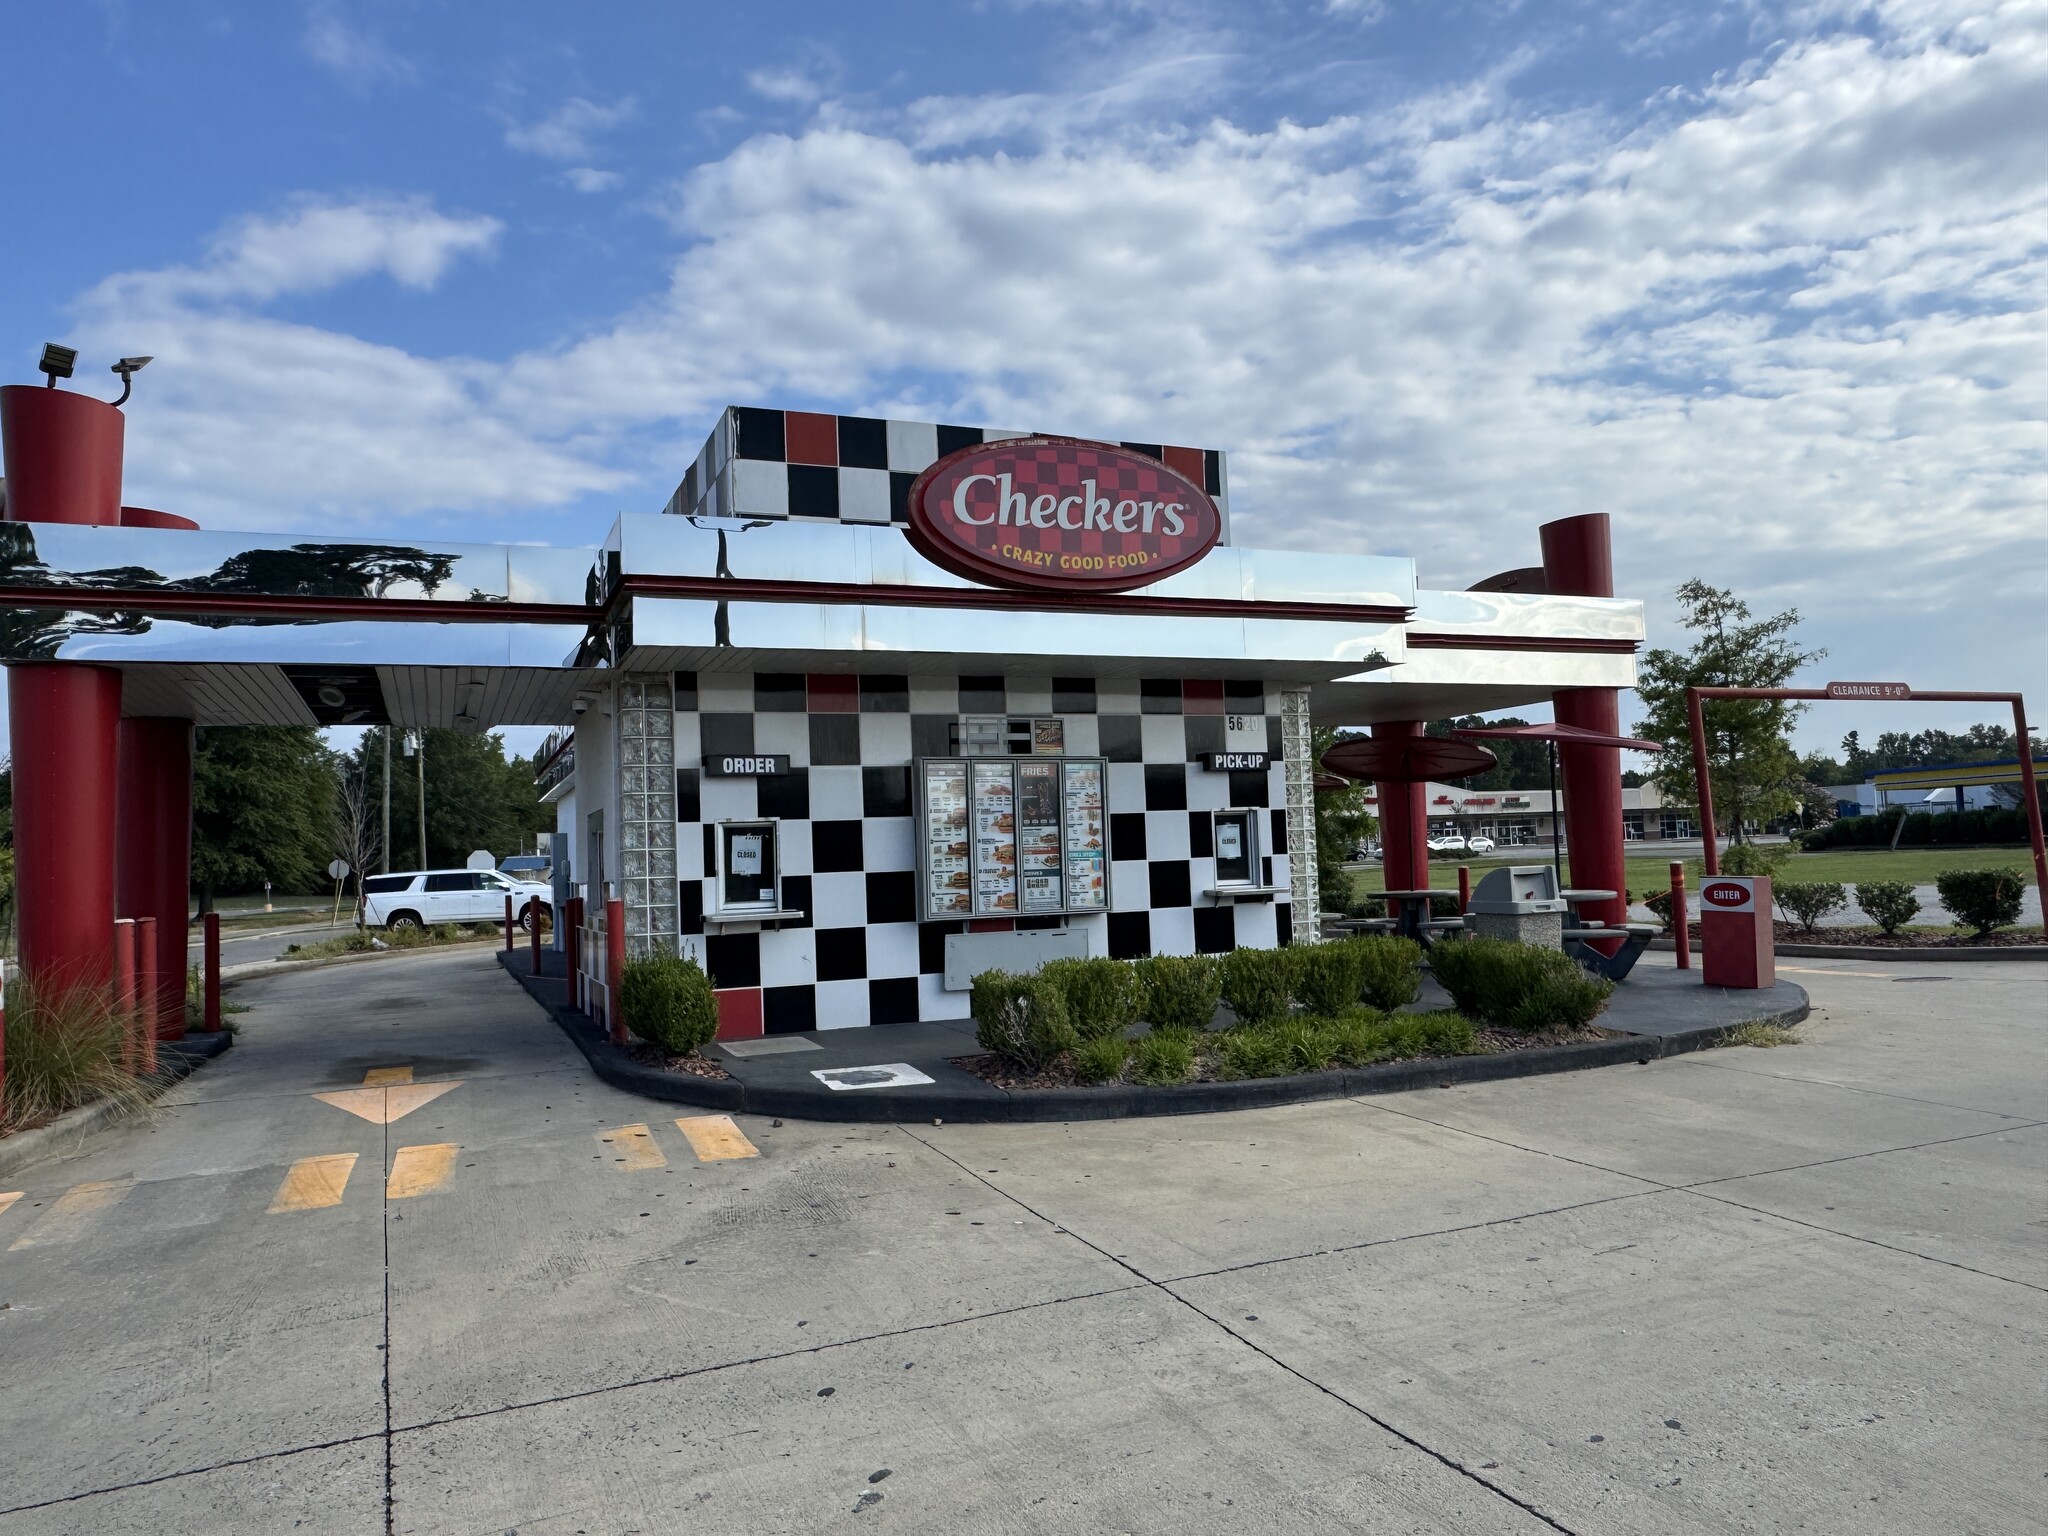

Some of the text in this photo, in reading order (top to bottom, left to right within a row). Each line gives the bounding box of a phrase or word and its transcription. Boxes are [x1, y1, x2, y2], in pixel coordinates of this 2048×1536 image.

[953, 473, 1185, 536] Checkers
[1003, 544, 1149, 570] CRAZY GOOD FOOD
[1832, 685, 1881, 696] CLEARANCE
[722, 758, 776, 774] ORDER
[1215, 754, 1264, 769] PICK-UP
[1021, 767, 1049, 776] FRIES
[737, 851, 757, 859] CLOSED
[1713, 890, 1741, 900] ENTER
